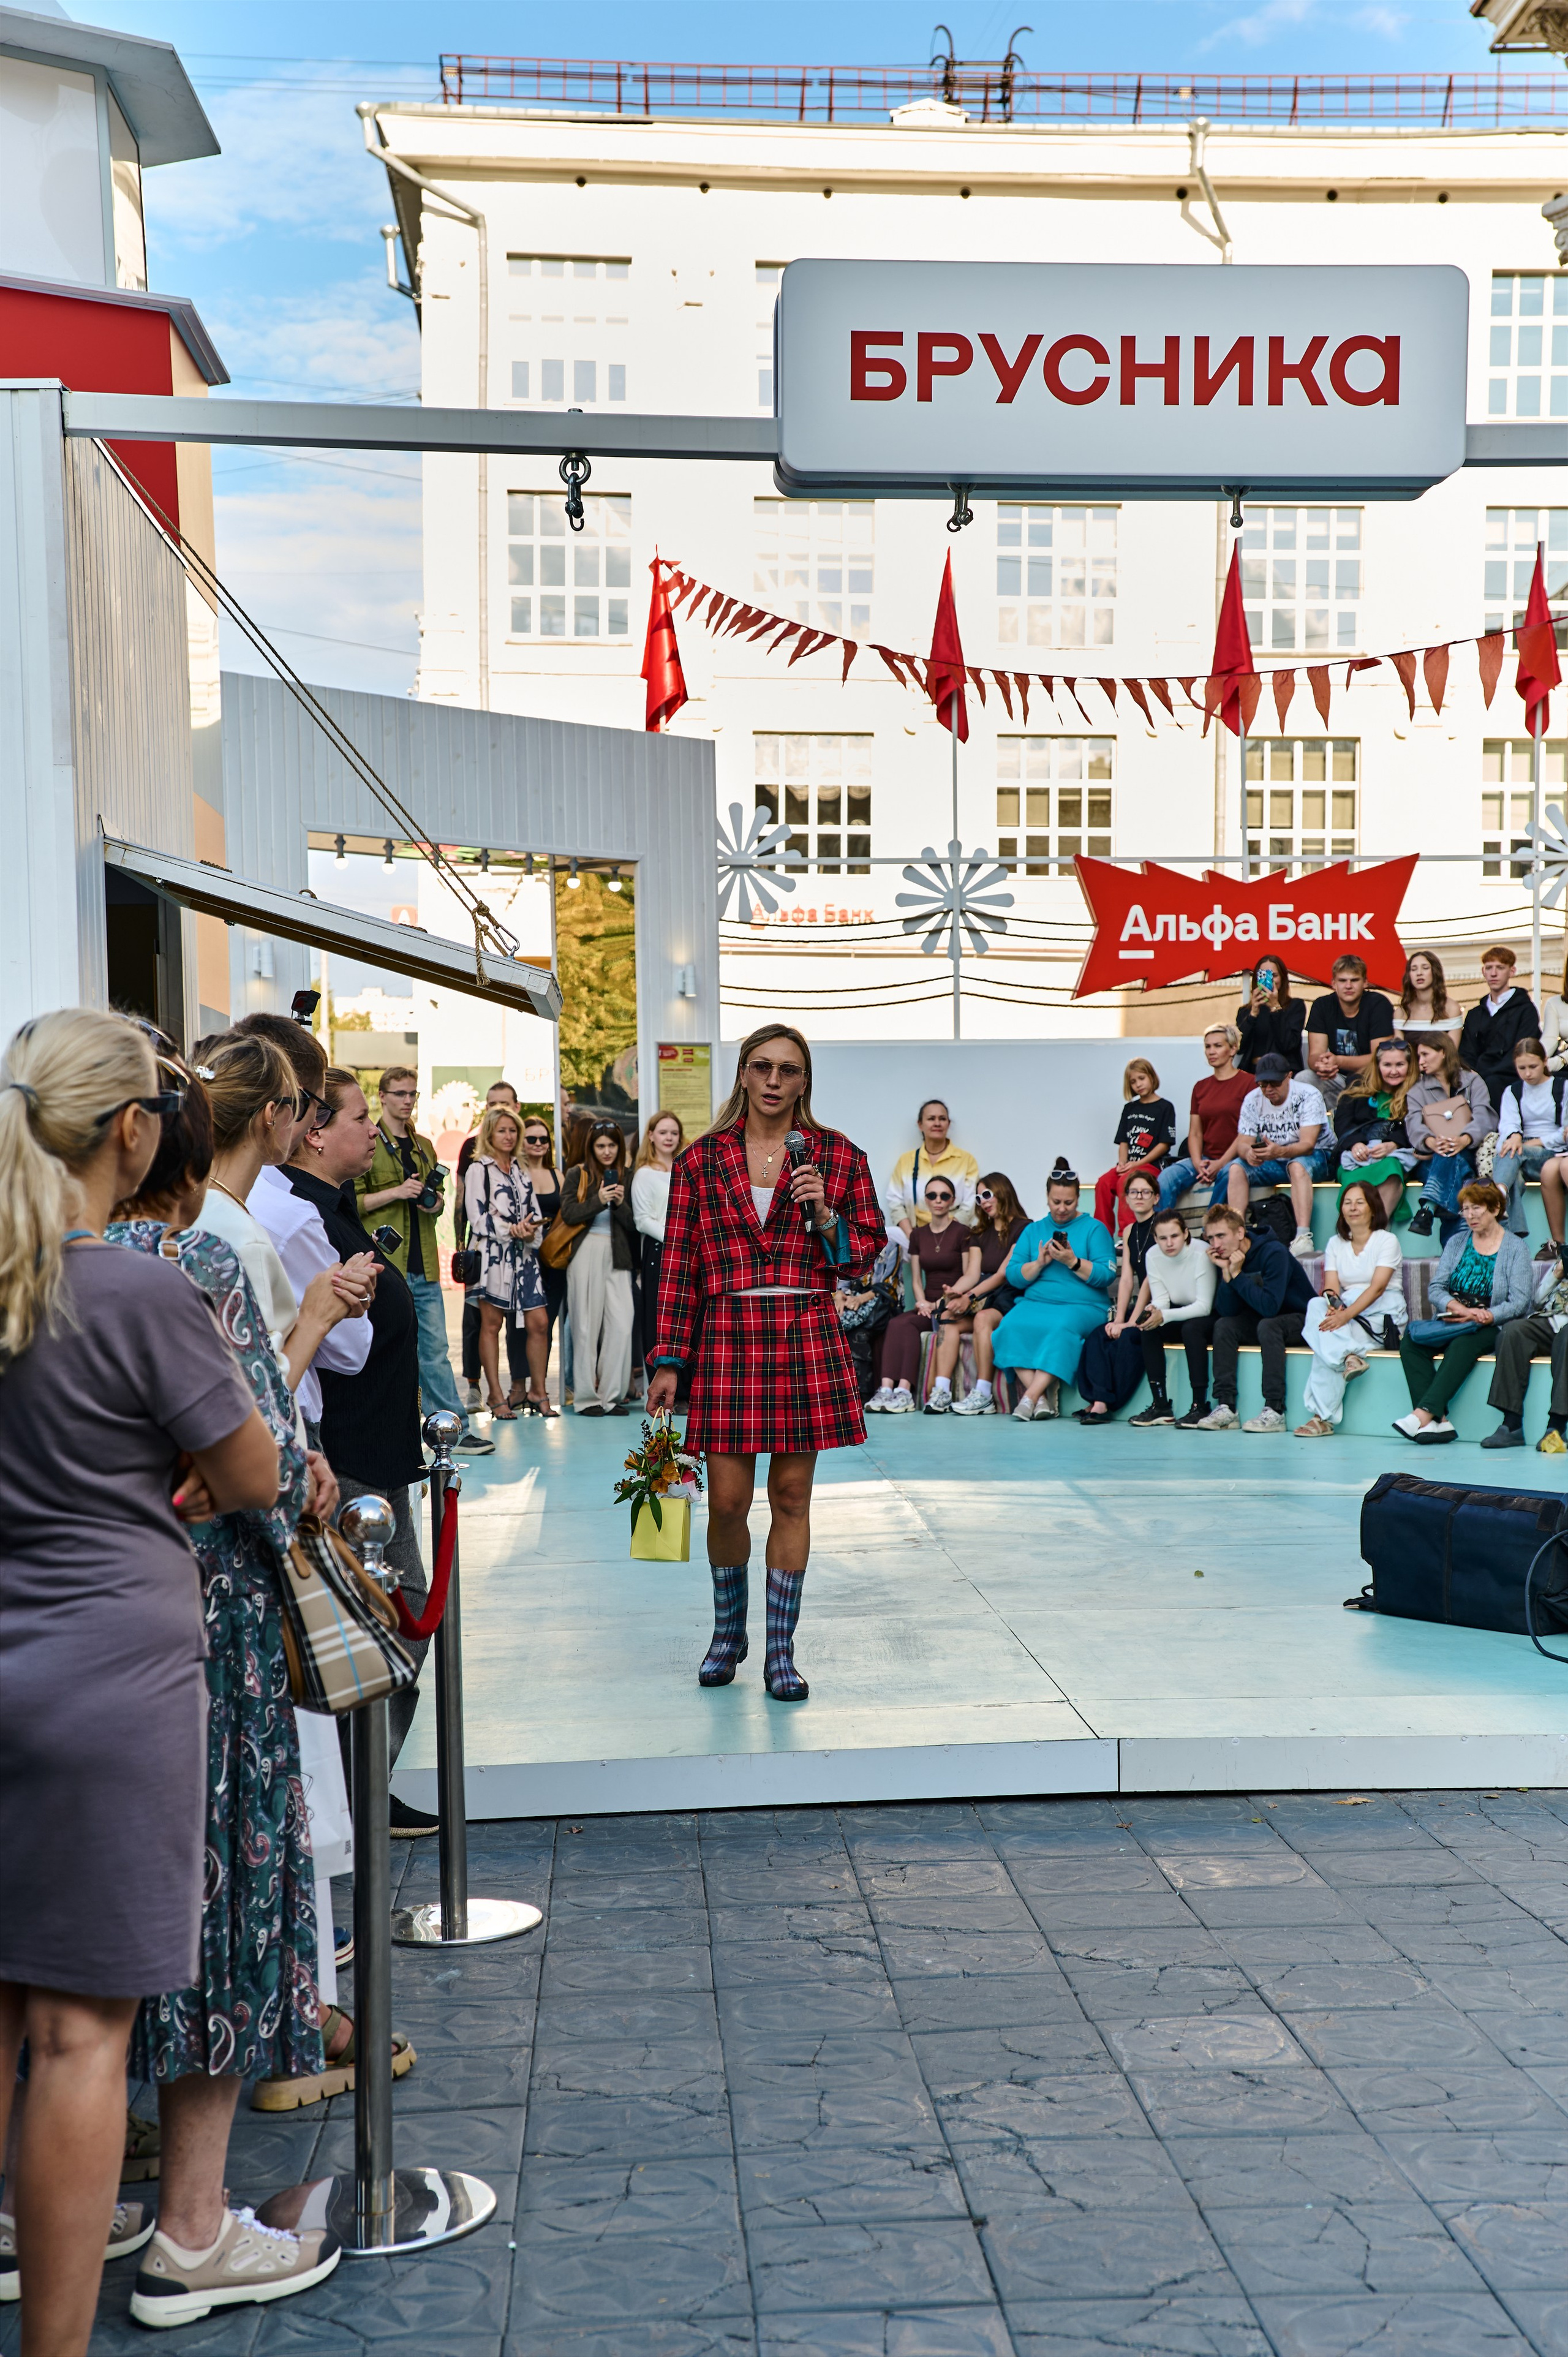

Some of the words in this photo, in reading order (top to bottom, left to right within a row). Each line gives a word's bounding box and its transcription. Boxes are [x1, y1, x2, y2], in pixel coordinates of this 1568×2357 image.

[824, 903, 875, 924] Банк
[1119, 904, 1259, 951] Альфа
[1268, 903, 1376, 941] Банк
